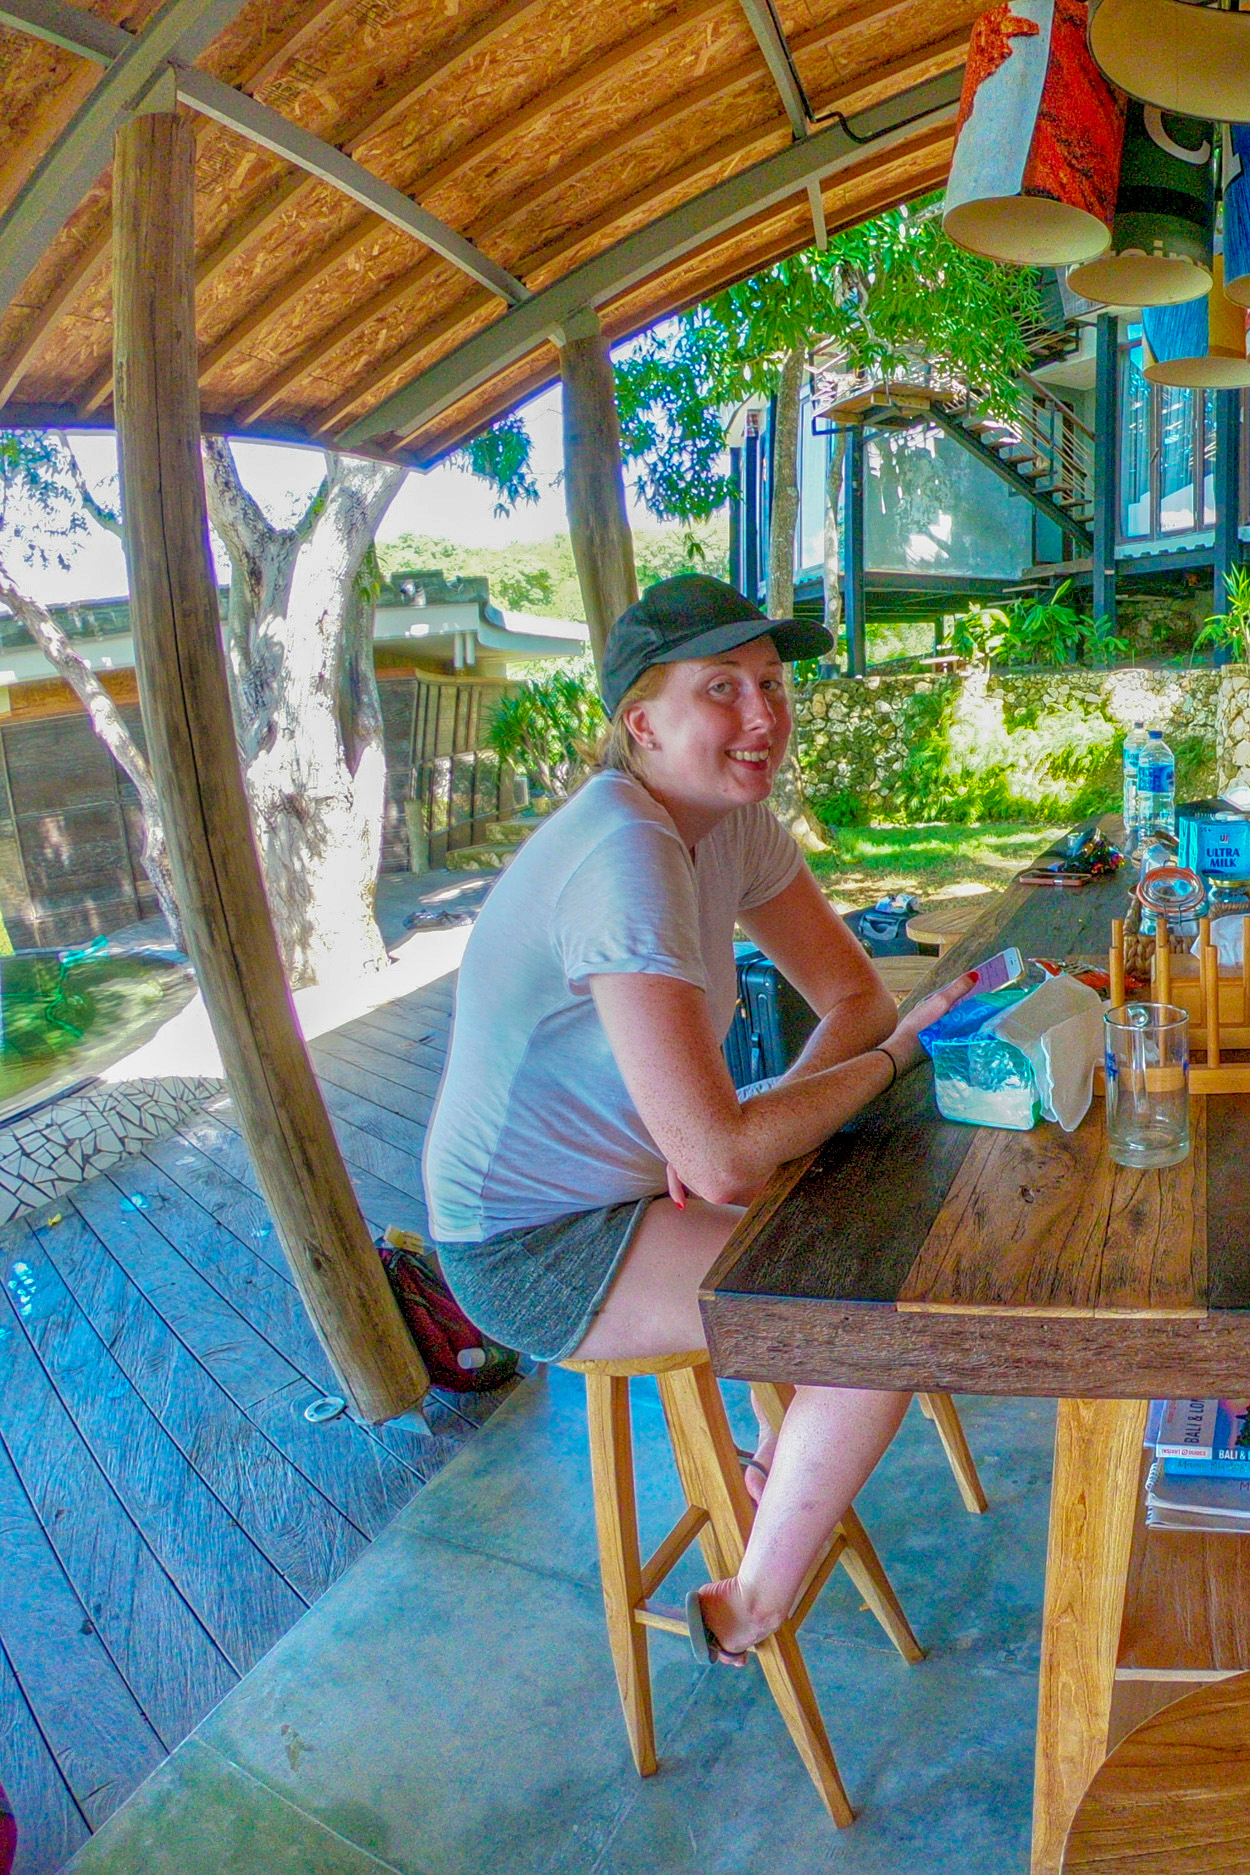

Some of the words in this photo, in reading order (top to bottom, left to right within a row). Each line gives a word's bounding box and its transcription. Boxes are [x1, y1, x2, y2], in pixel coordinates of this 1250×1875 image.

[1206, 848, 1240, 857] ULTRA
[1209, 858, 1237, 868] MILK
[1184, 1423, 1201, 1444] BALI
[1218, 1449, 1238, 1460] BALI
[1239, 1450, 1246, 1460] &
